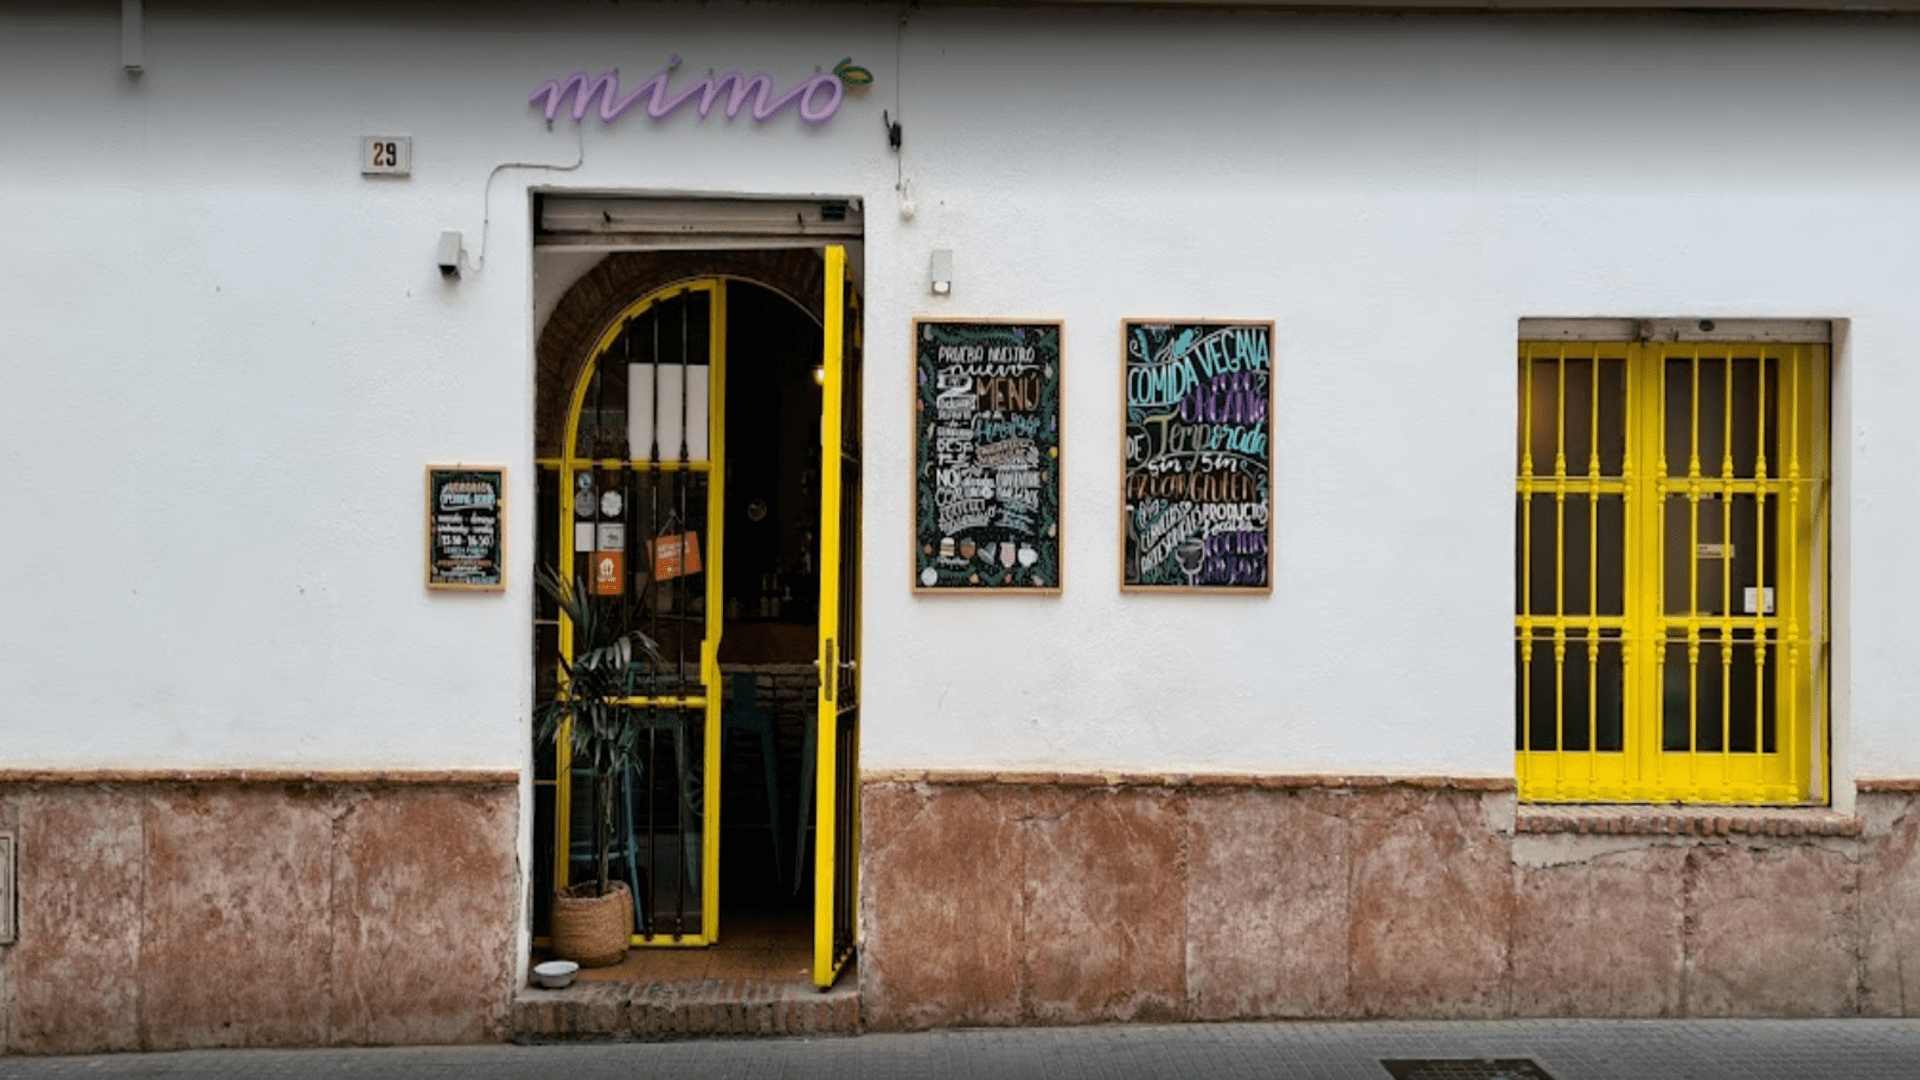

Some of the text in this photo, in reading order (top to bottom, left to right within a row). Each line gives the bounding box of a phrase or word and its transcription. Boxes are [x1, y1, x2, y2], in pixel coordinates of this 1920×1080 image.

[529, 53, 844, 125] mimo
[373, 142, 397, 167] 29
[938, 345, 1036, 363] PRUEBA NUESTRO
[946, 363, 1038, 377] nuevo
[1128, 331, 1269, 405] COMIDA VEGANA
[976, 372, 1040, 412] MENÚ
[1148, 453, 1237, 476] sin sin
[1190, 471, 1259, 502] GLUTEN
[1202, 499, 1268, 524] PRODUCTOS
